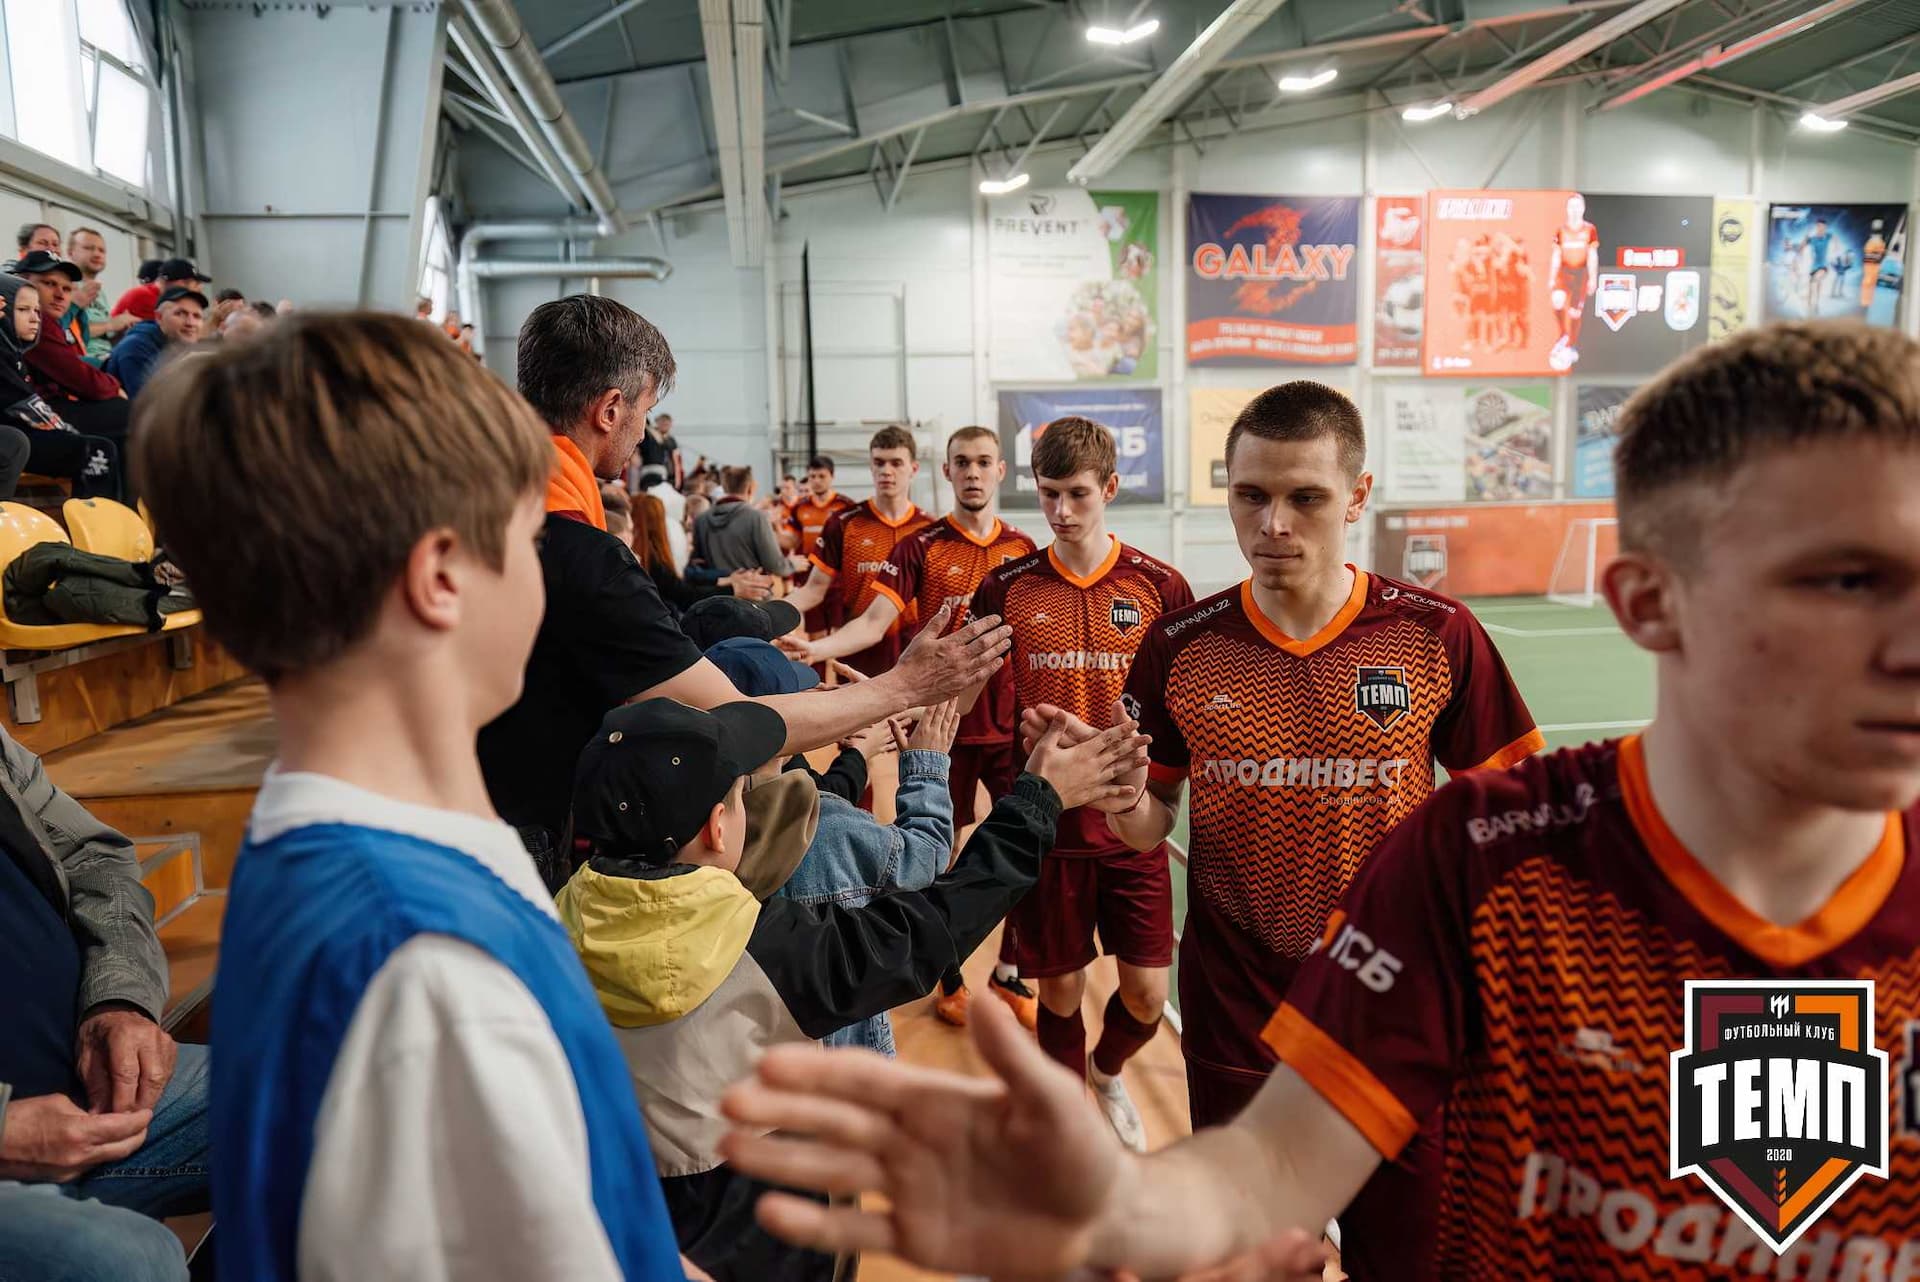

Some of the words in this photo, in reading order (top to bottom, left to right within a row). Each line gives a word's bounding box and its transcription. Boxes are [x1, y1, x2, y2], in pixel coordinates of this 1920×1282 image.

[995, 219, 1079, 235] PREVENT
[1193, 243, 1355, 281] GALAXY
[1112, 608, 1139, 625] ТЕМП
[1027, 650, 1136, 671] ПРОДИНВЕС
[1360, 684, 1406, 708] ТЕМП
[1205, 757, 1409, 789] ПРОДИНВЕСТ
